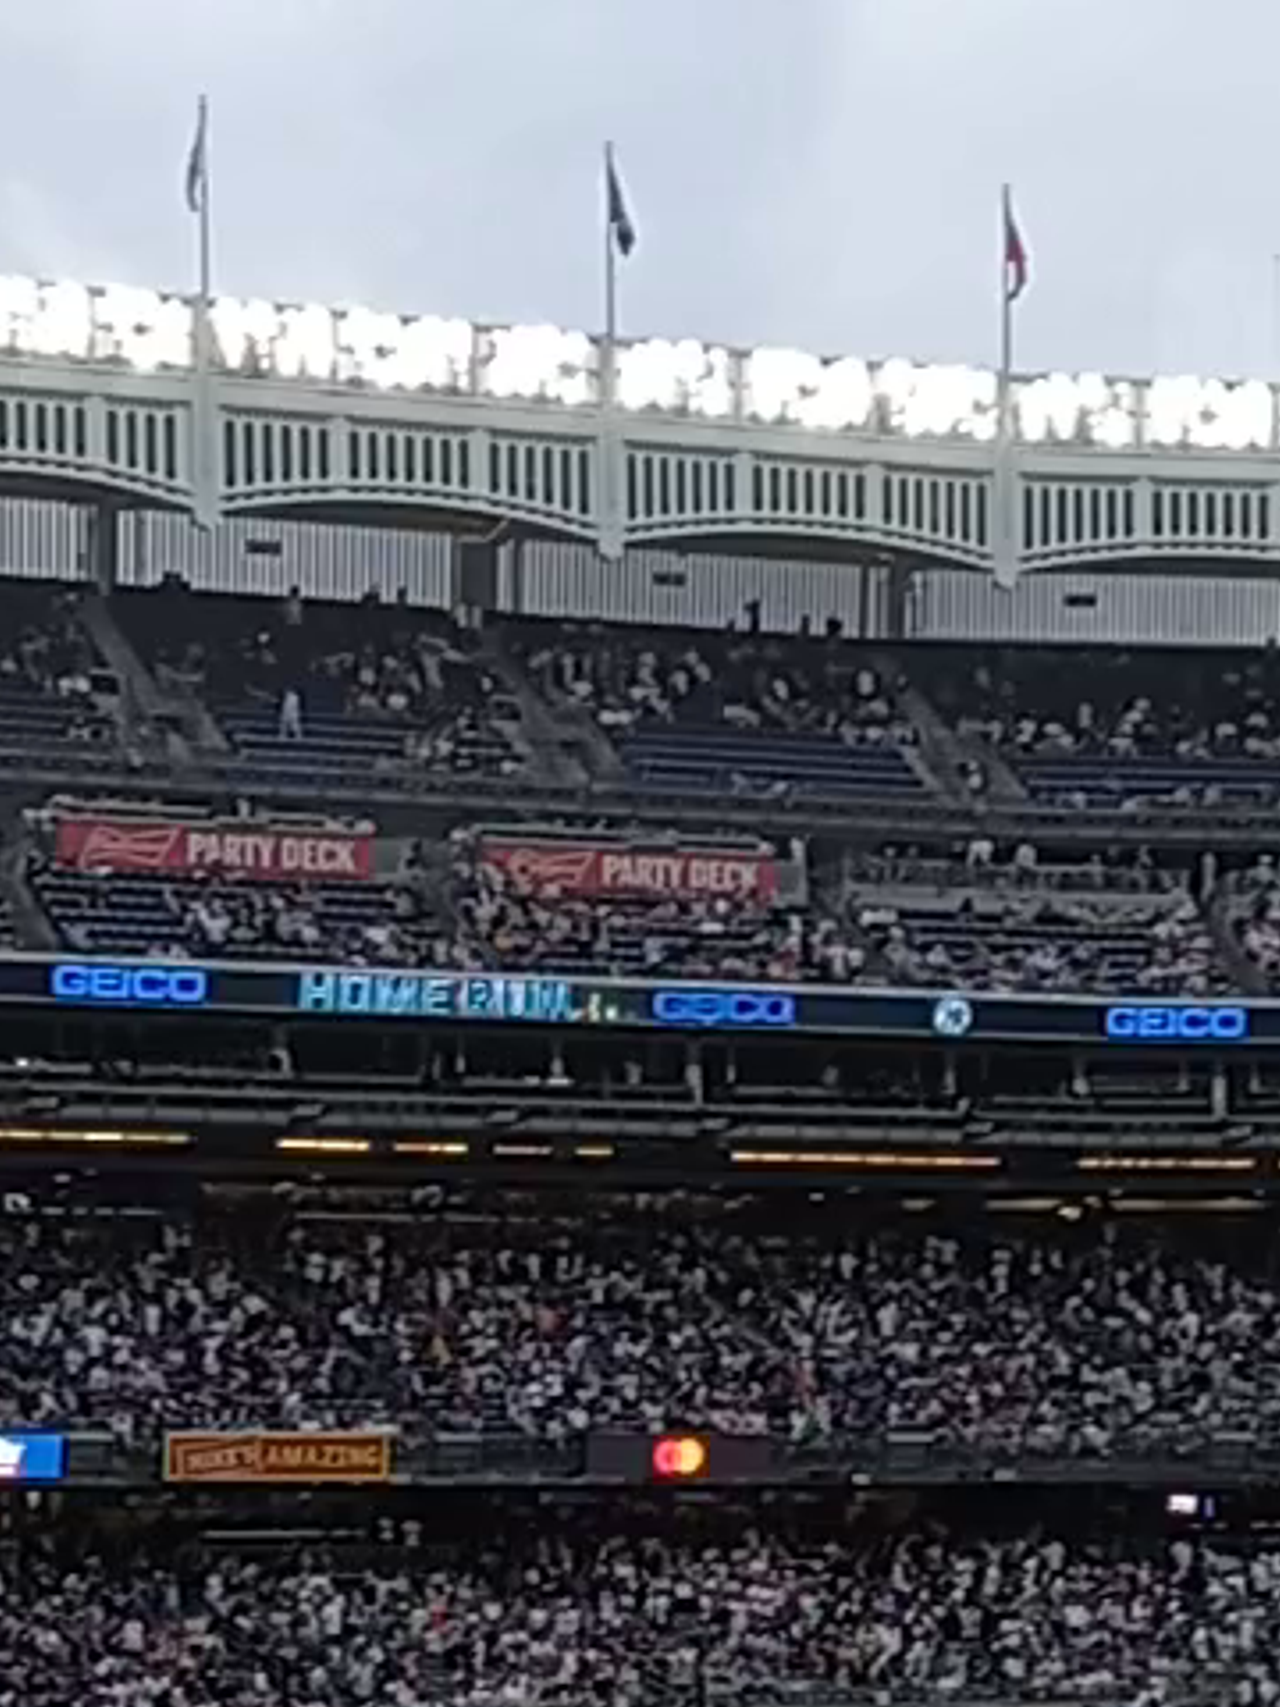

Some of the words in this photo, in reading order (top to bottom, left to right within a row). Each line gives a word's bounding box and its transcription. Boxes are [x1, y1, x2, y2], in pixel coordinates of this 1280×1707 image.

[187, 833, 274, 865] PARTY
[282, 839, 357, 871] DECK
[600, 853, 686, 887] PARTY
[691, 859, 757, 891] DECK
[53, 965, 206, 1002] GEICO
[297, 973, 451, 1011] HOME
[1106, 1007, 1246, 1038] GEICO
[264, 1444, 380, 1468] AMAZING
